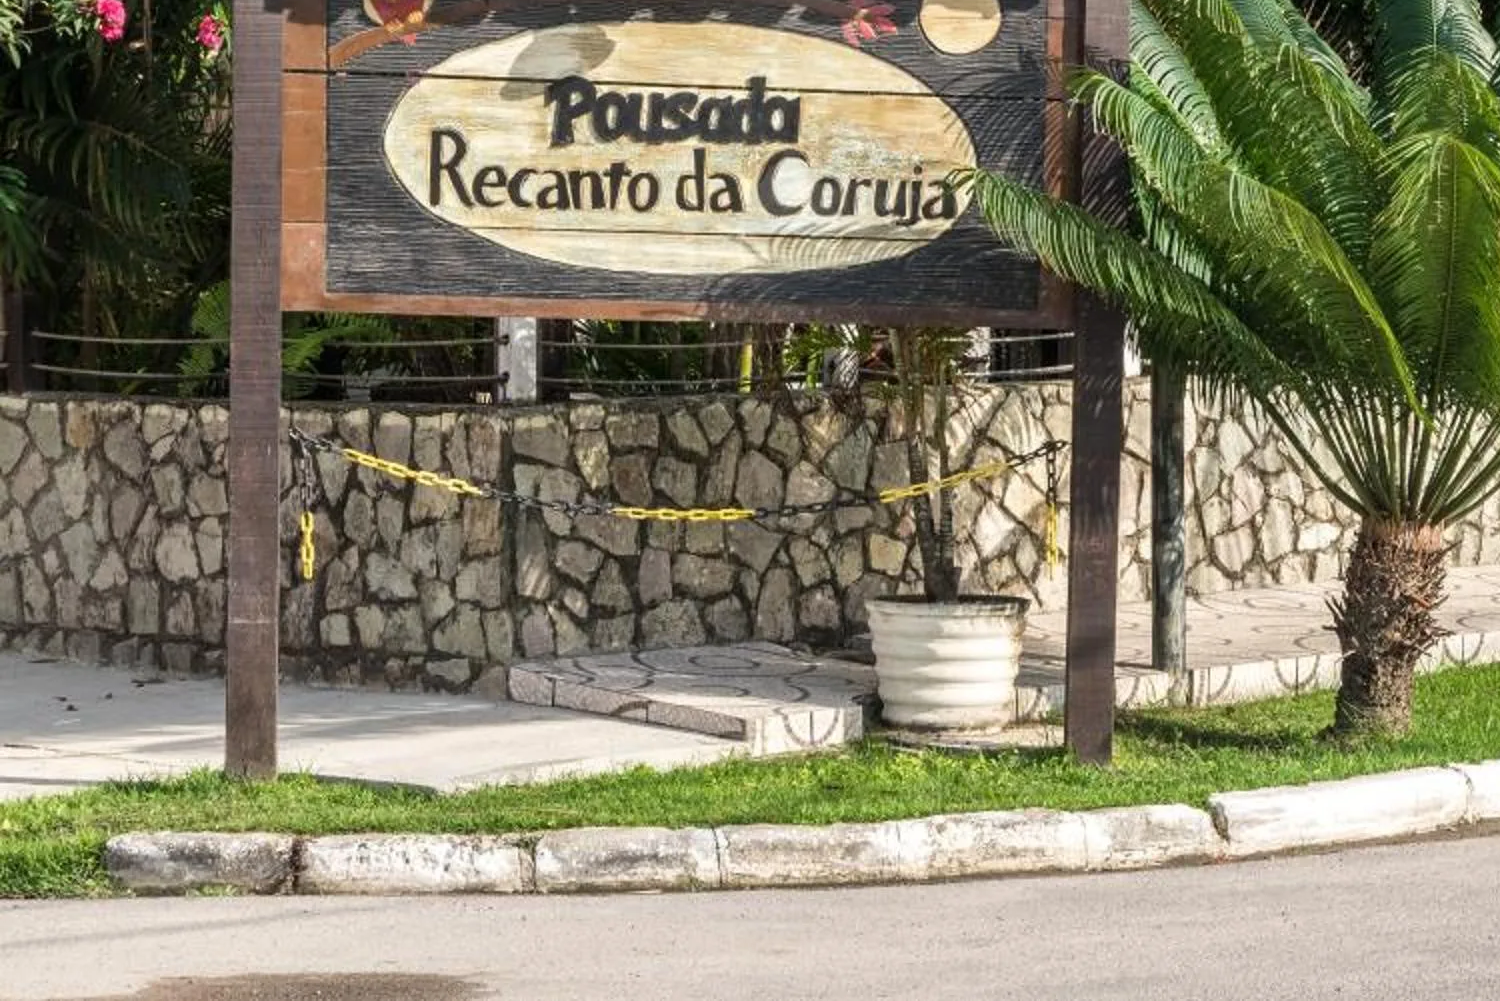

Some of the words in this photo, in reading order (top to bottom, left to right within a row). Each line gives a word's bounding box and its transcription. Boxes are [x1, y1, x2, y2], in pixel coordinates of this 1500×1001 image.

[545, 76, 801, 147] Pousada
[428, 129, 660, 213] Recanto
[675, 149, 743, 214] da
[757, 149, 958, 226] Coruja
